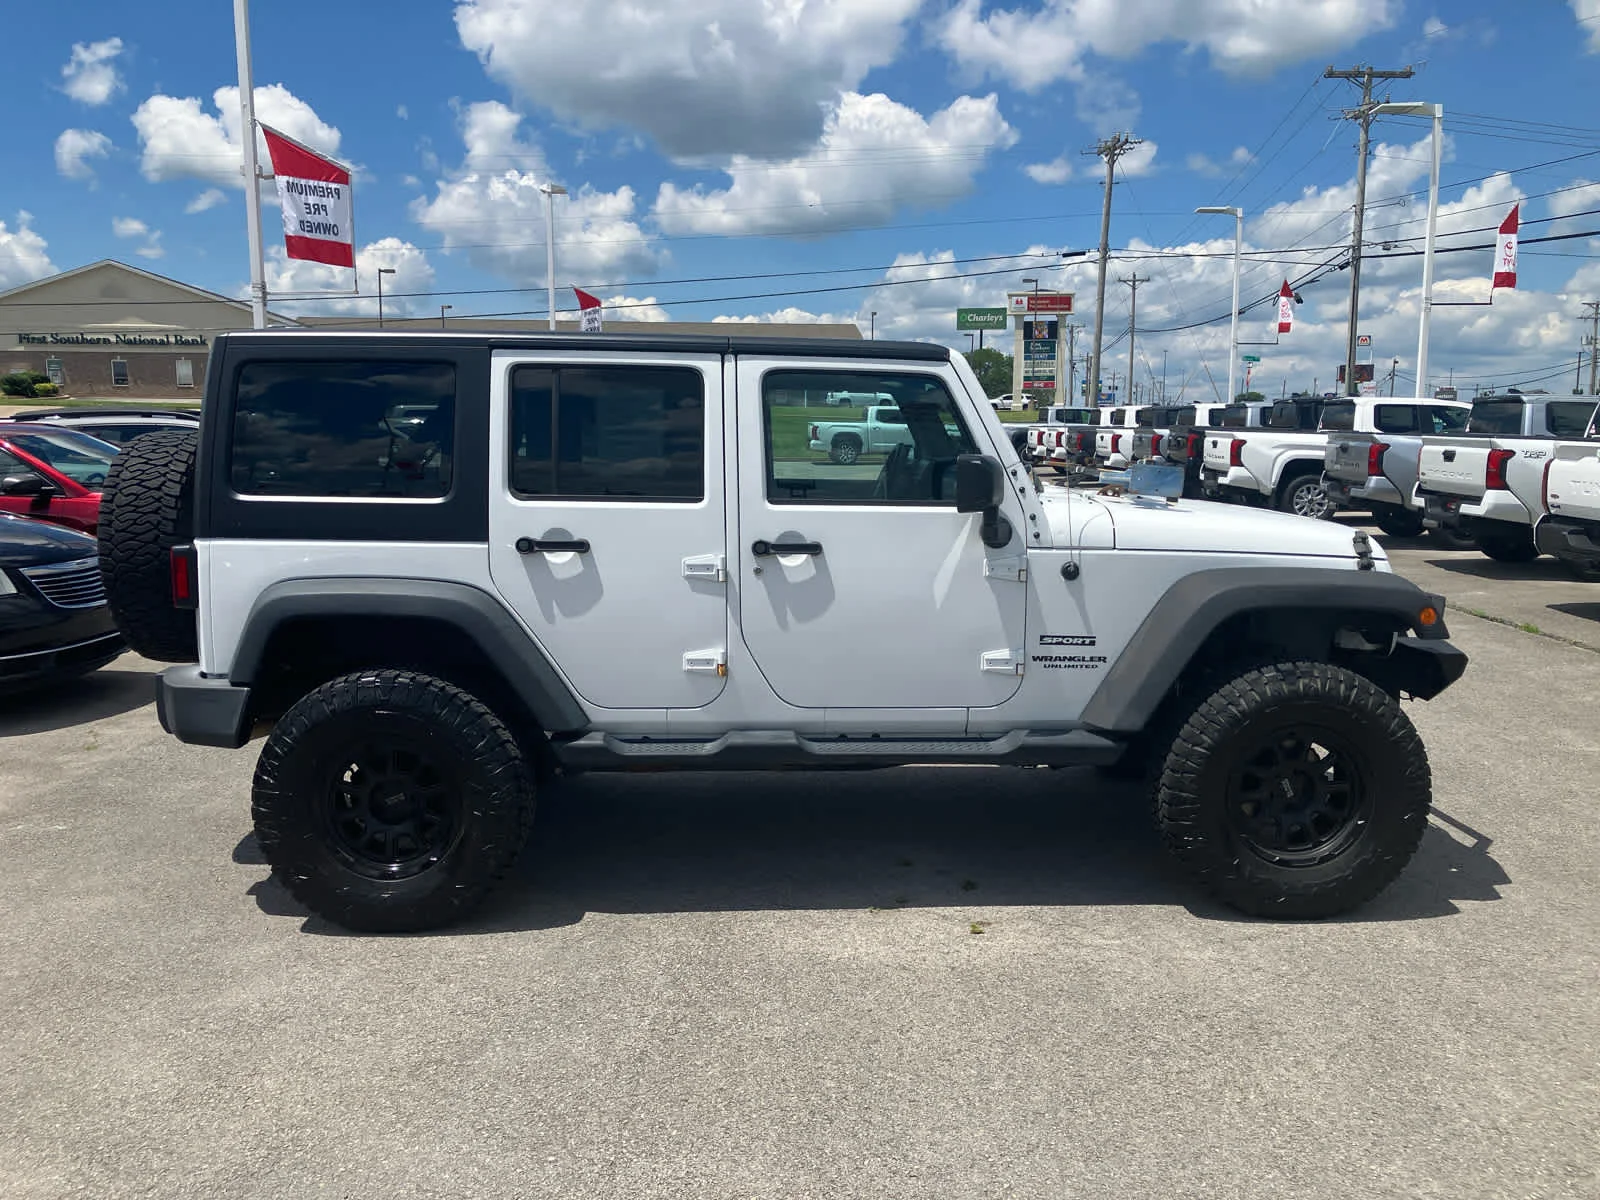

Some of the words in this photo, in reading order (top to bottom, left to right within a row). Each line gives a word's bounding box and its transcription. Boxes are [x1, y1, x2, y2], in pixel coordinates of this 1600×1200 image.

[967, 313, 1003, 324] Charleys
[18, 333, 49, 344] First
[50, 333, 111, 345] Southern
[114, 334, 171, 346] National
[174, 334, 209, 346] Bank
[1040, 636, 1094, 645] SPORT
[1031, 655, 1107, 663] WRANGLER
